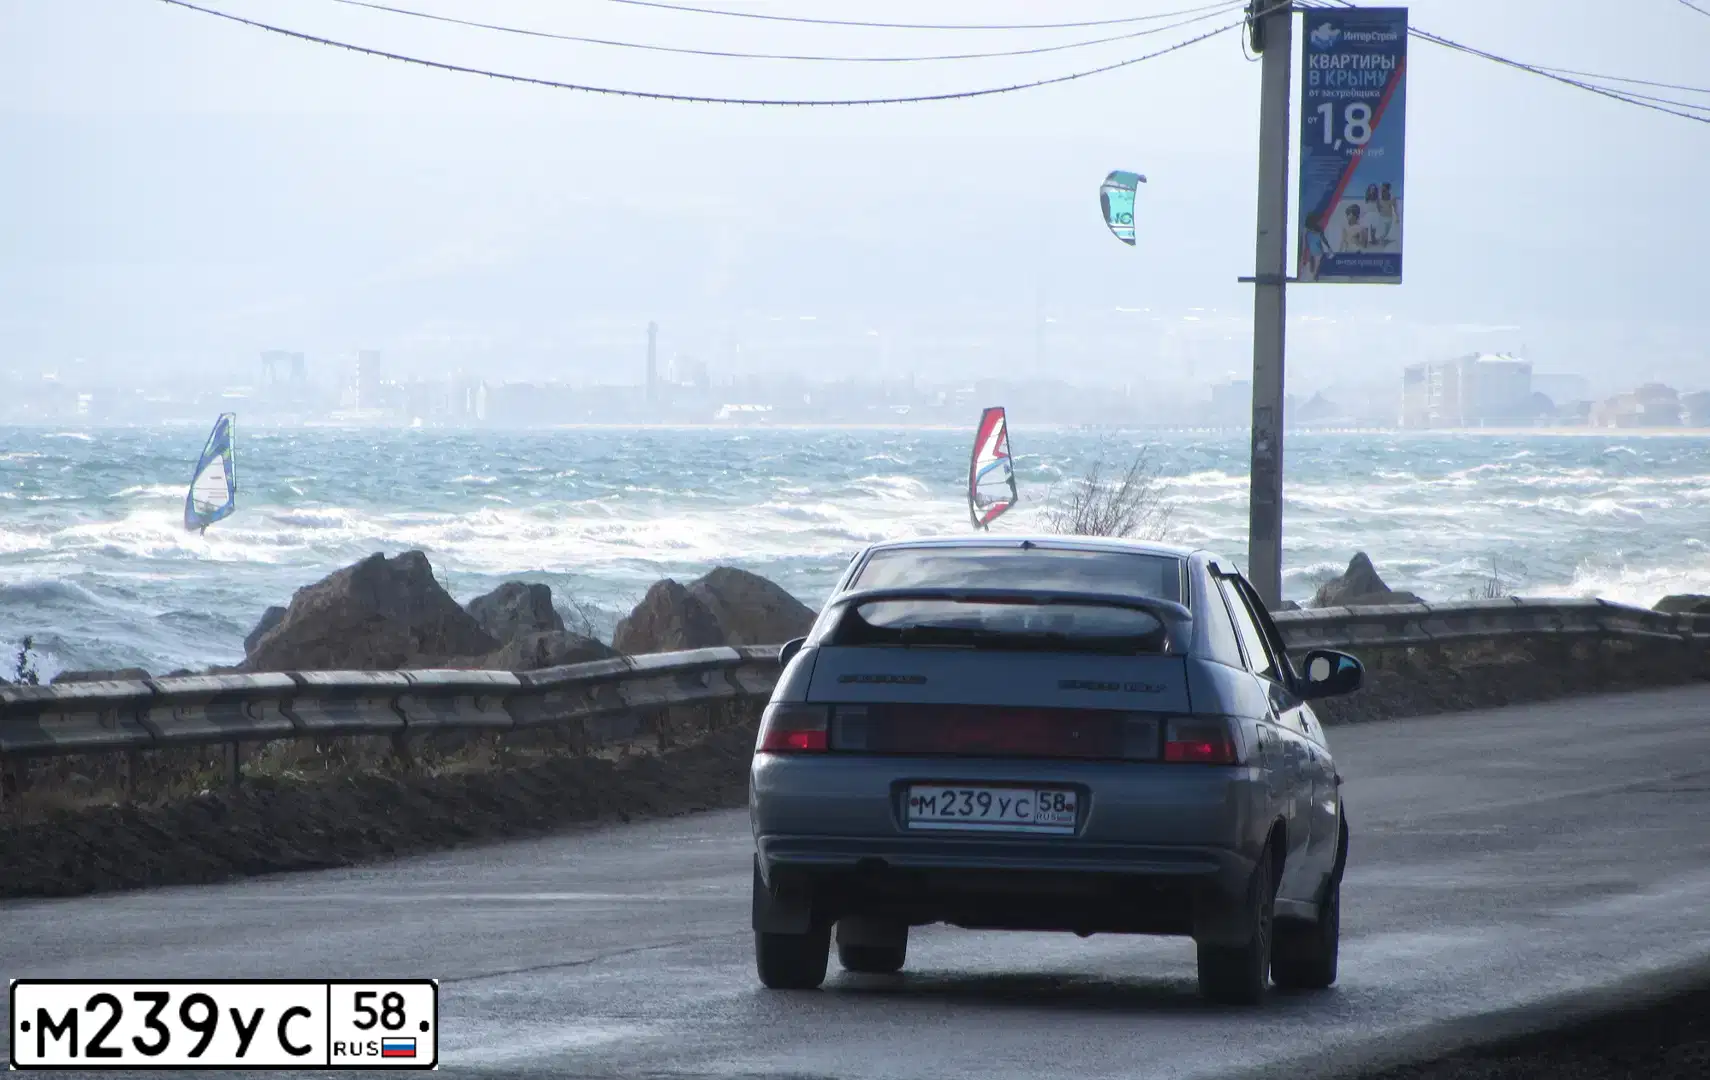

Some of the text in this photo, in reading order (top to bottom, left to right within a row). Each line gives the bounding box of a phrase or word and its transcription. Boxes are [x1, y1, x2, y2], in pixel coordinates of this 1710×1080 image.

[1309, 53, 1395, 69] КВАРТИРЫ
[1309, 70, 1388, 87] В КРЫМУ
[1317, 102, 1372, 151] 1,8
[1039, 792, 1066, 812] 58
